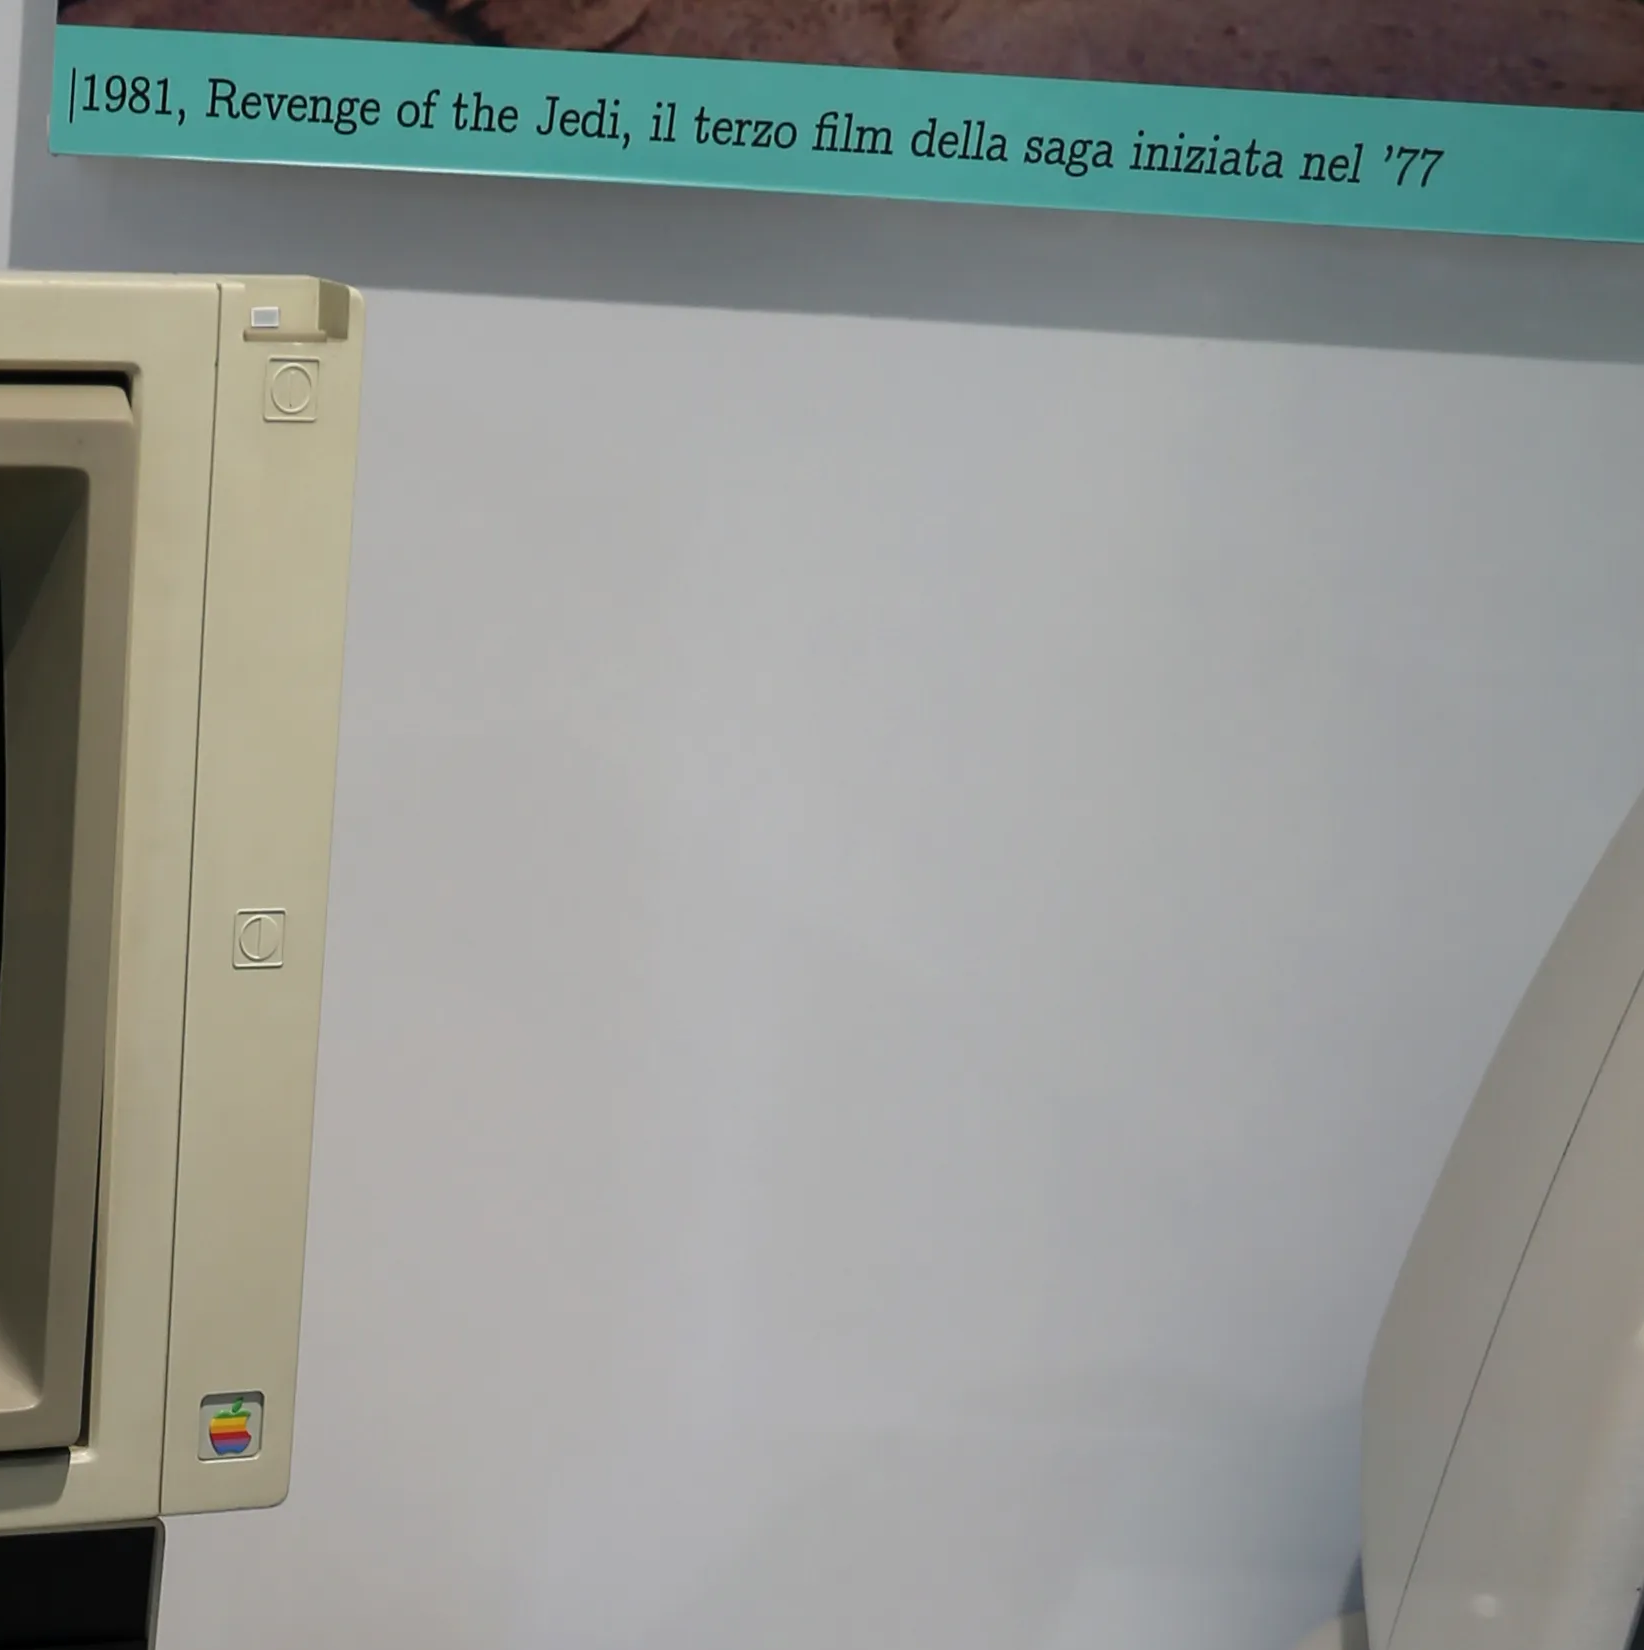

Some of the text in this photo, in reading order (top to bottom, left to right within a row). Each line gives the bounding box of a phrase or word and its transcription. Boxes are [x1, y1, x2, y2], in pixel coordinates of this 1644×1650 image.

[205, 78, 381, 135] Revenge
[397, 89, 441, 129] of
[453, 92, 519, 133] the
[536, 96, 631, 150] Jedi,
[649, 102, 678, 143] il
[694, 106, 797, 149] terzo
[812, 111, 894, 156] film
[910, 117, 1008, 162] della
[1023, 133, 1114, 178] saga
[1129, 129, 1284, 179] iniziata
[1299, 143, 1364, 184] nel
